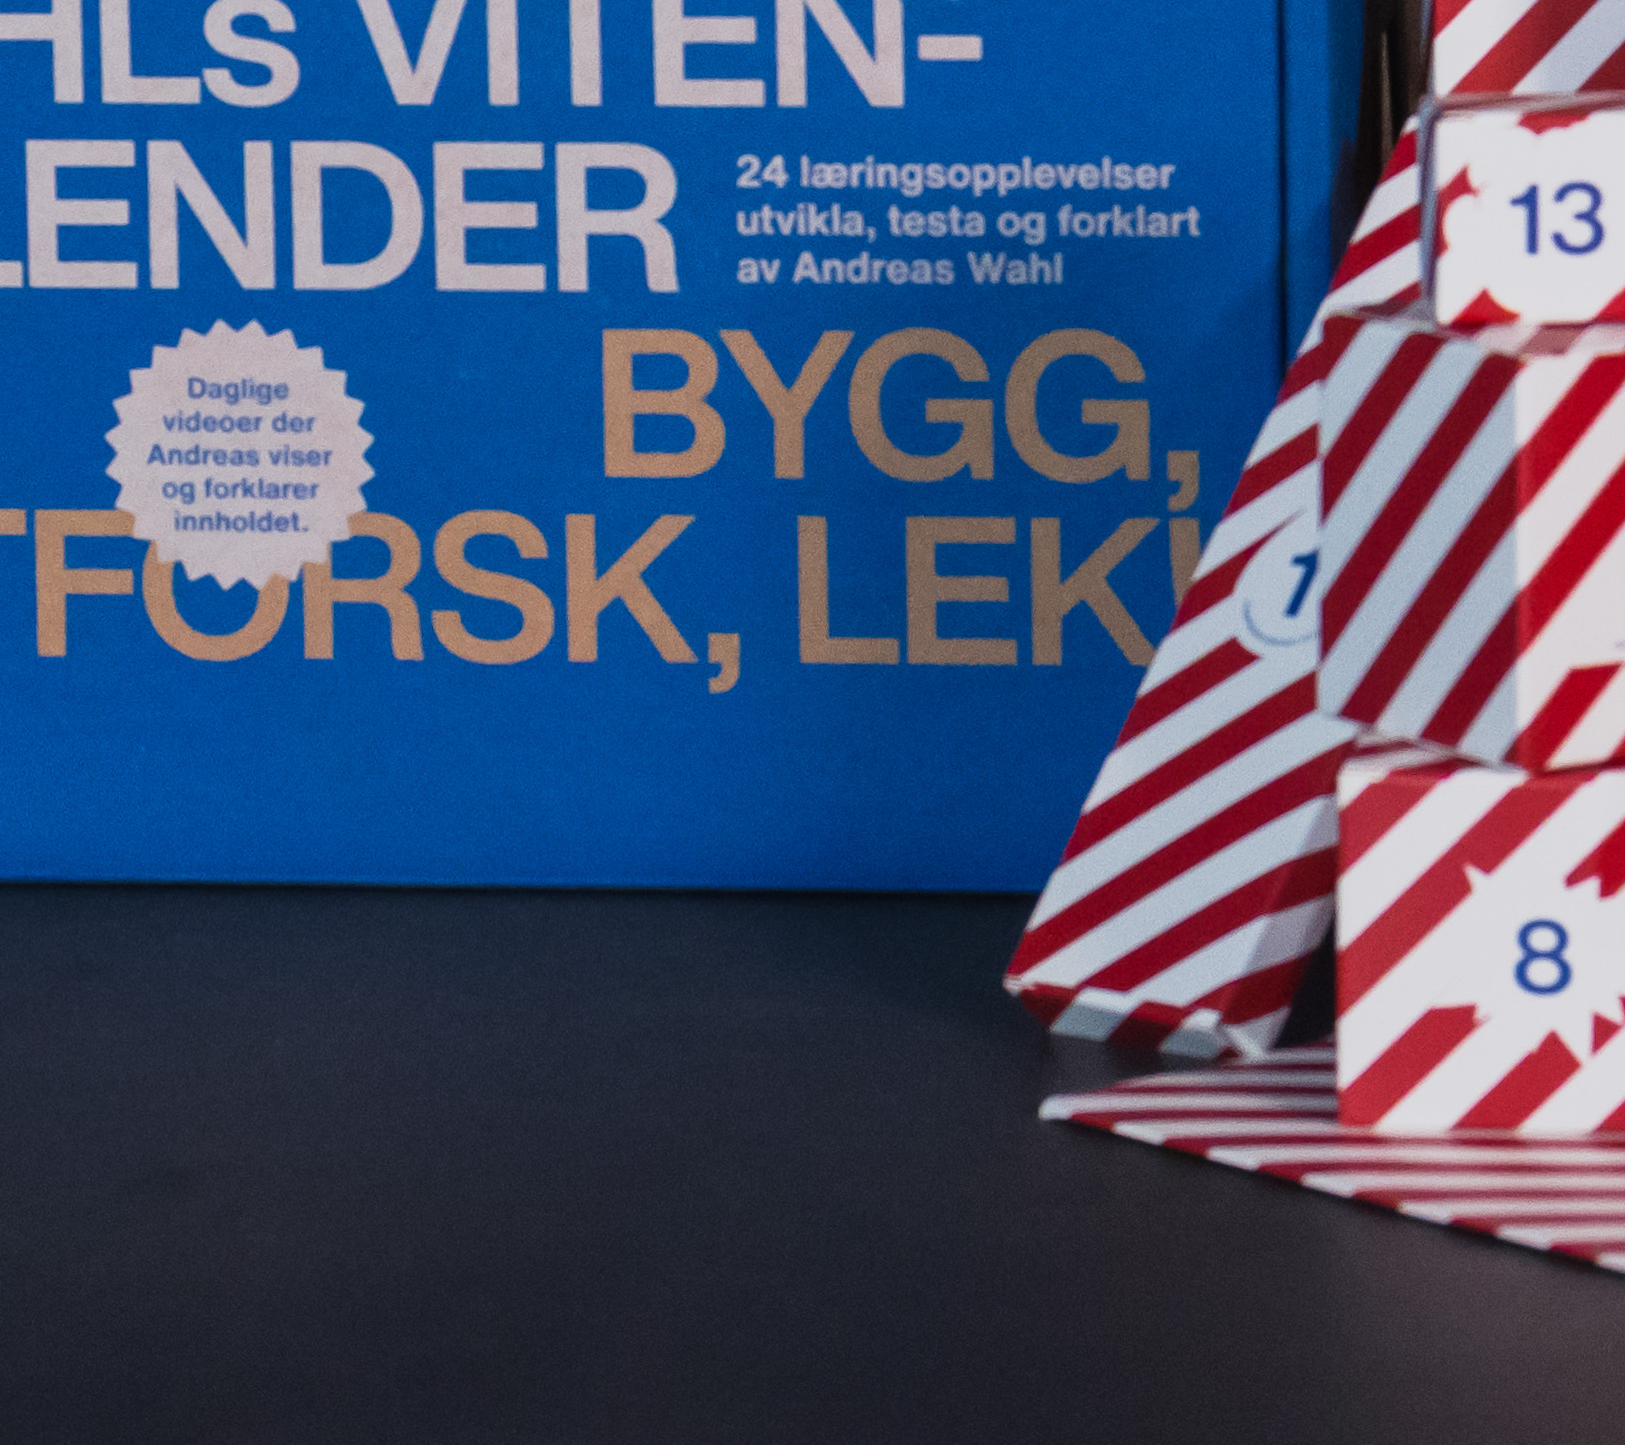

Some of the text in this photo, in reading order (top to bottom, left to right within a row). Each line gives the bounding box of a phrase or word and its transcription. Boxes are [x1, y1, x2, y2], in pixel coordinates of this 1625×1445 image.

[736, 154, 1175, 197] 24 læringsopplevelser
[736, 203, 1200, 246] utvikla, testa og forklart
[1510, 181, 1606, 257] 13
[736, 251, 1063, 285] av Andreas Wahl
[187, 376, 289, 405] Daglige
[162, 411, 315, 434] videoer der
[602, 327, 1200, 511] BYGG,
[147, 443, 333, 467] Andreas viser
[162, 477, 319, 505] og forklarer
[174, 510, 309, 534] innholdet.
[1514, 919, 1573, 997] 8
